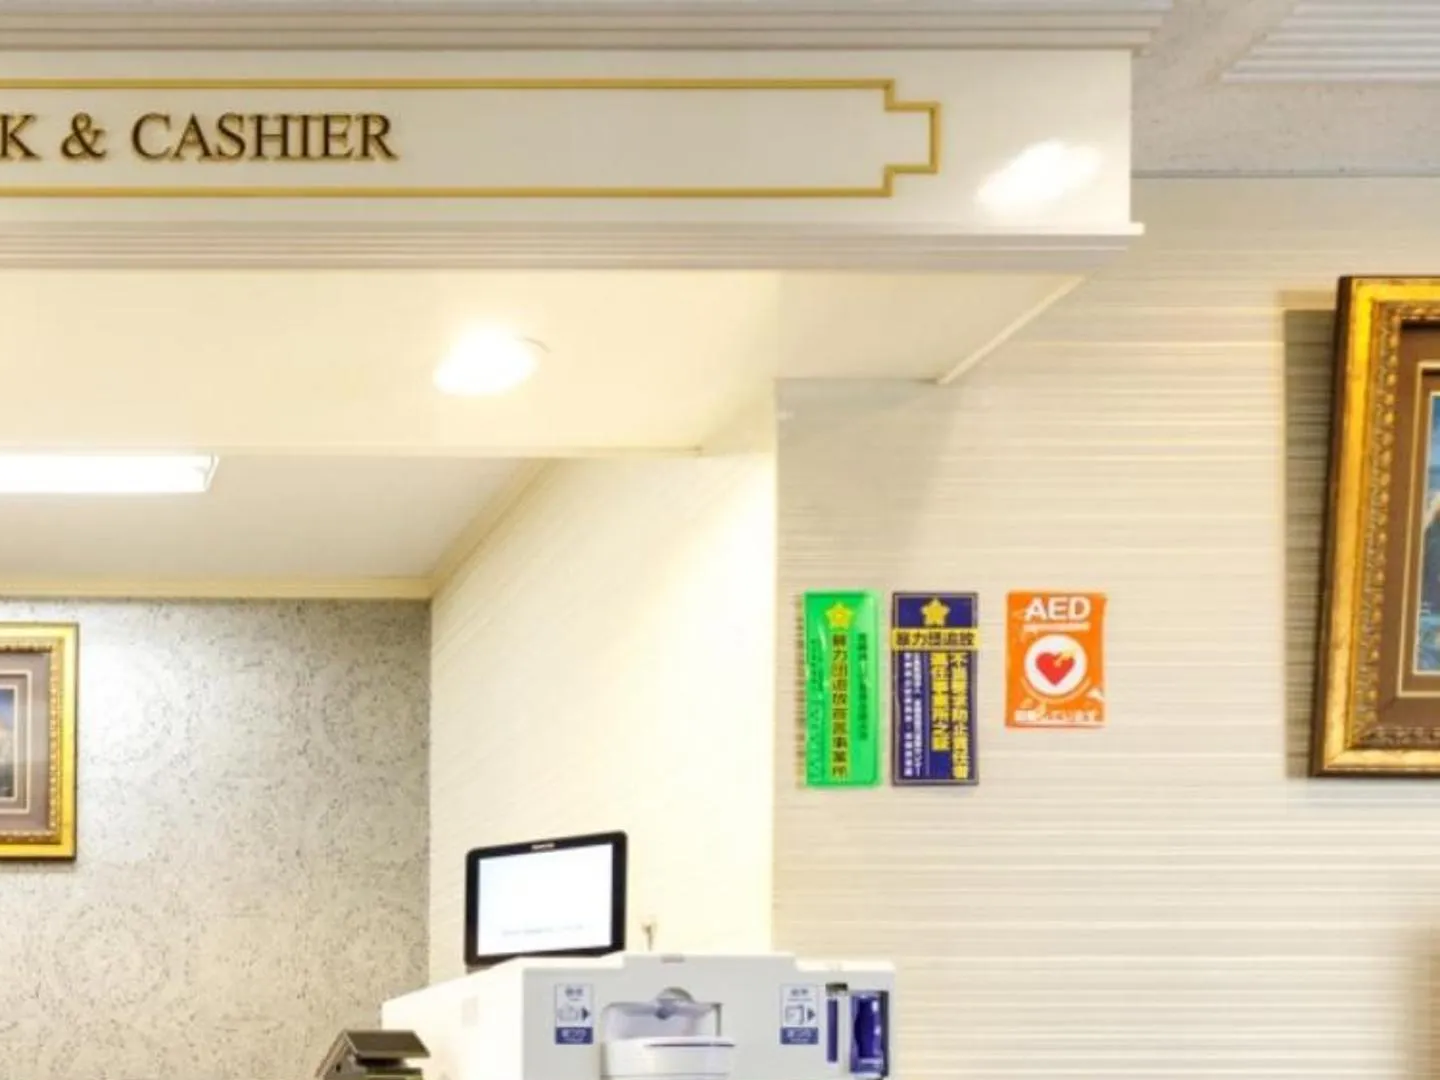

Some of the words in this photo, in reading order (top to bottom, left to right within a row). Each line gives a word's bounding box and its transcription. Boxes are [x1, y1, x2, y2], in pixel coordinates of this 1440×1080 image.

[60, 111, 107, 161] &
[131, 111, 399, 162] CASHIER
[1024, 595, 1092, 622] AED
